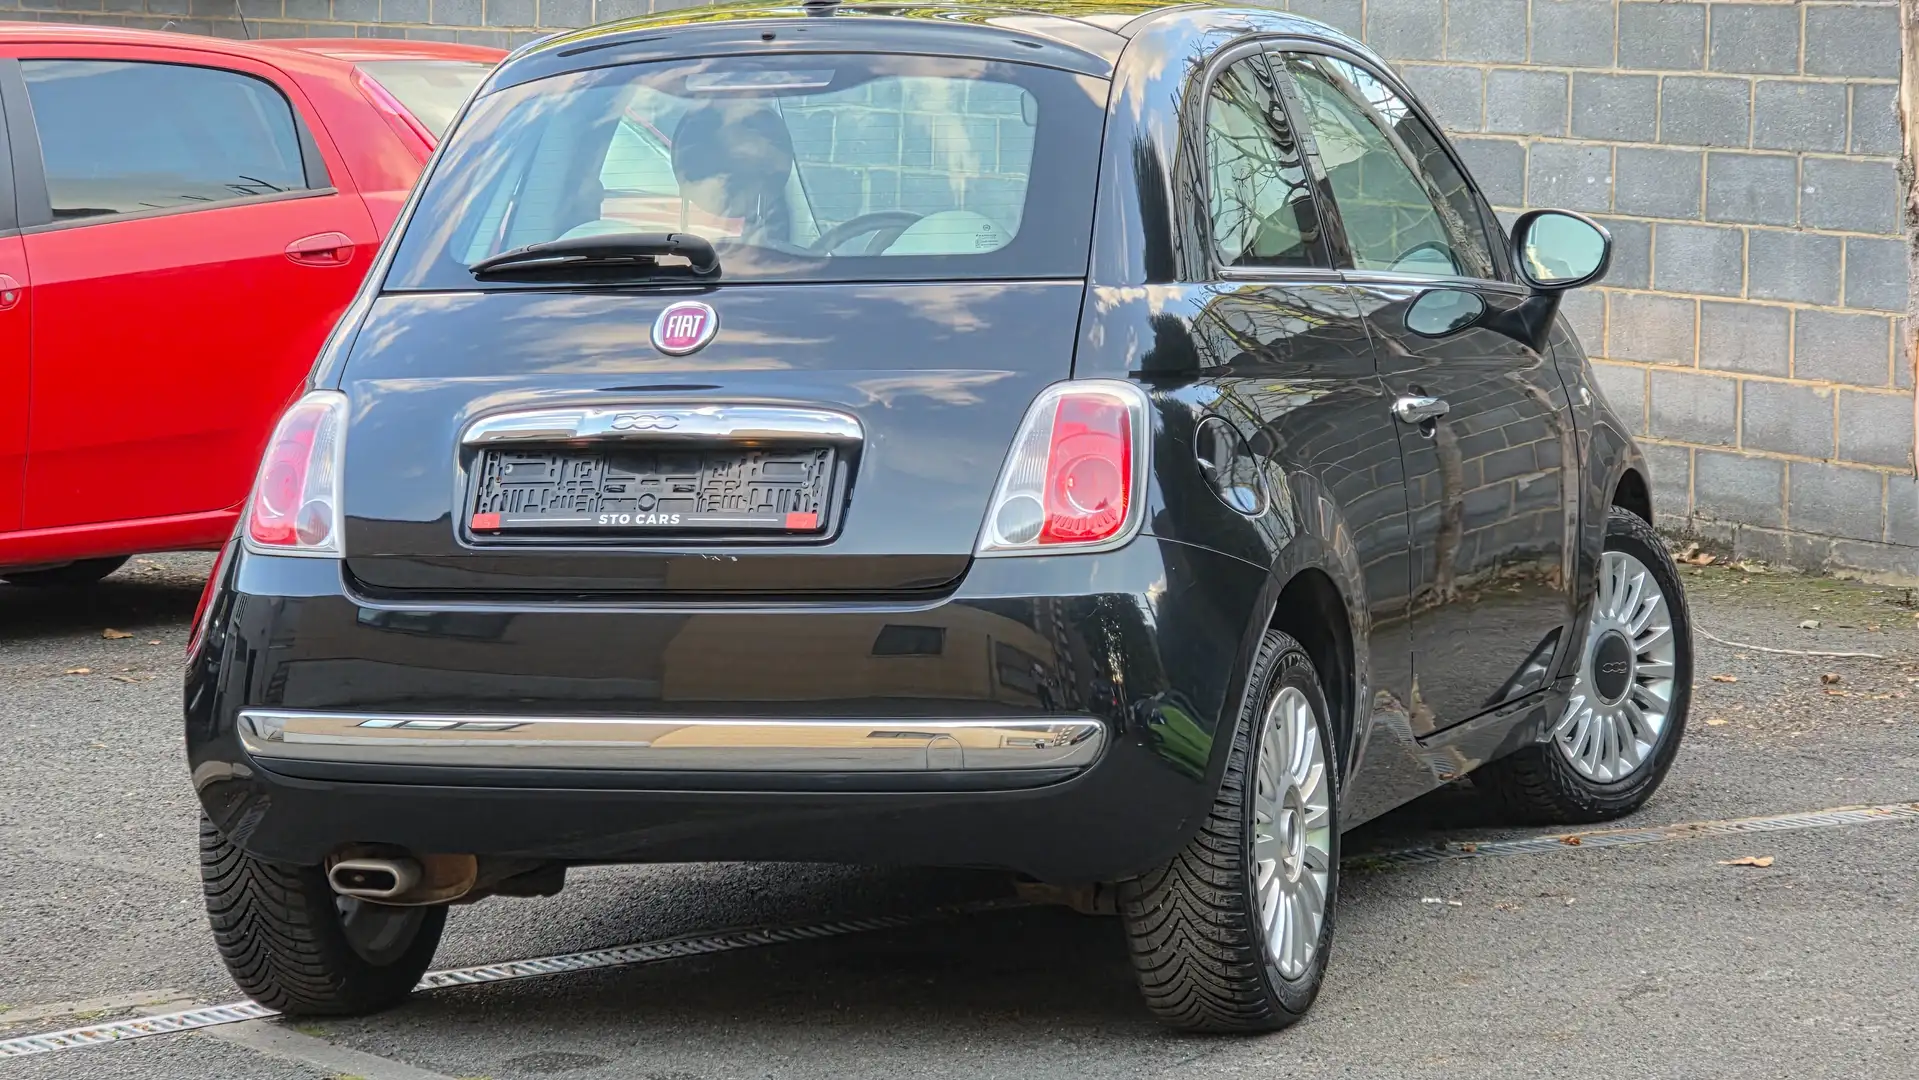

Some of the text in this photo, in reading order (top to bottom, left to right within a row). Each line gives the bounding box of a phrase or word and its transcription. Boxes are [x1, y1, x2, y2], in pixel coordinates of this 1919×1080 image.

[665, 315, 704, 338] FIAT
[611, 413, 680, 430] 500
[598, 513, 680, 525] STO CARS
